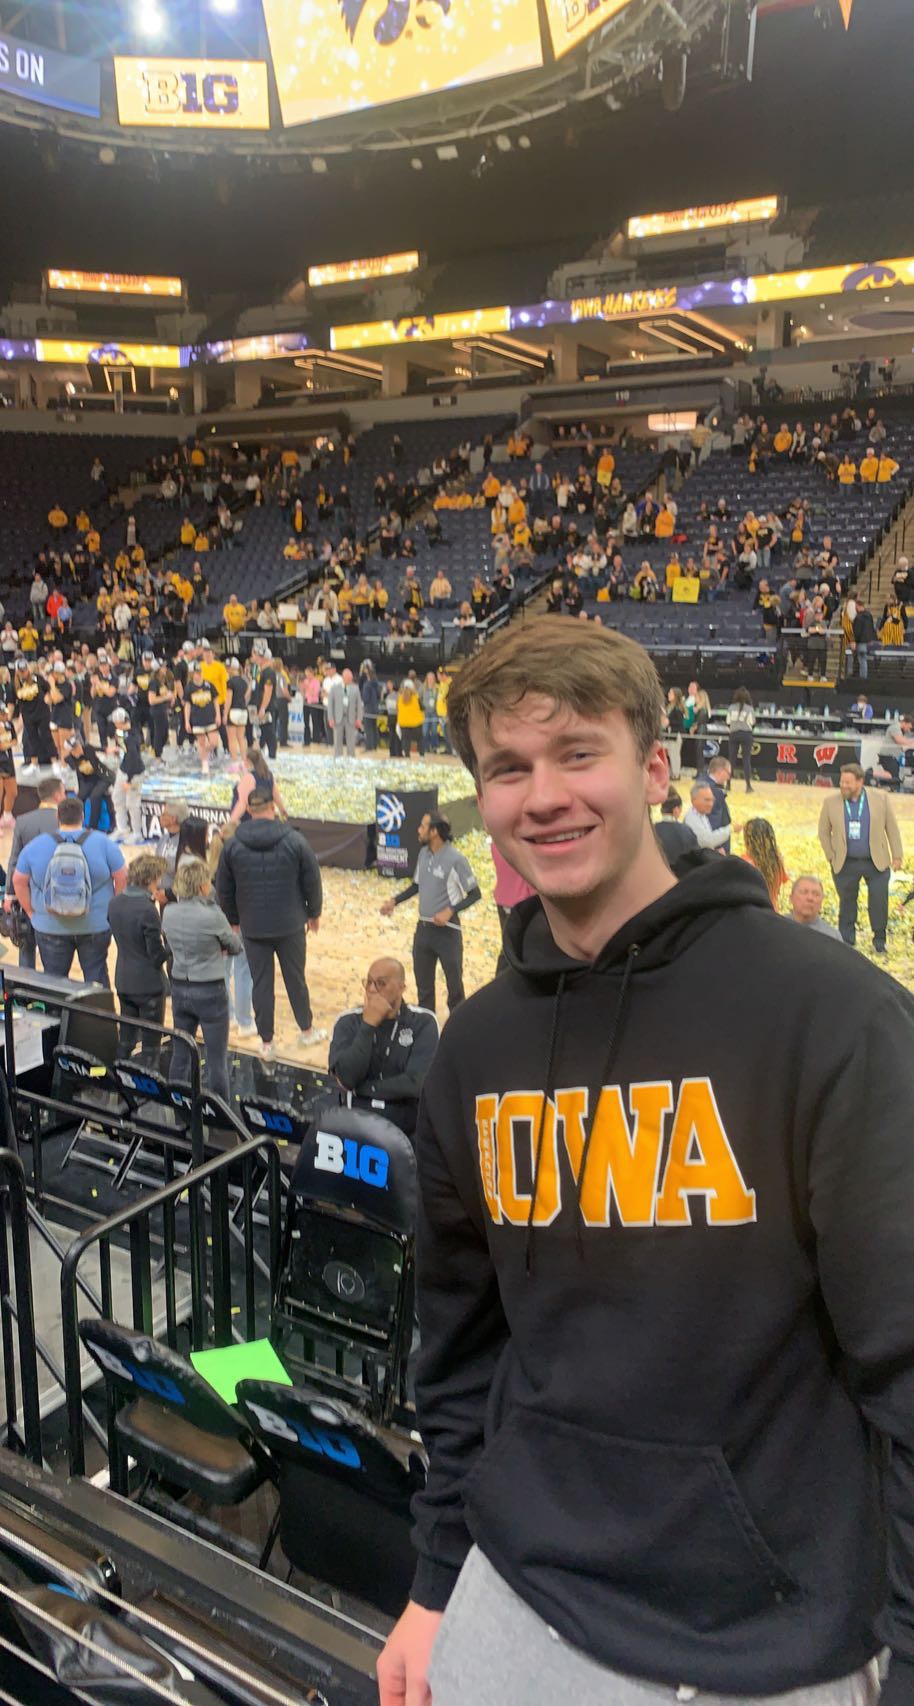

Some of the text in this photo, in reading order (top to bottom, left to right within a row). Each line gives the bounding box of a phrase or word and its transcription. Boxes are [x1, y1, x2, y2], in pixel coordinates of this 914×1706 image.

[16, 47, 44, 86] ON
[777, 743, 797, 764] R
[814, 743, 838, 767] W
[475, 1076, 757, 1228] IOWA
